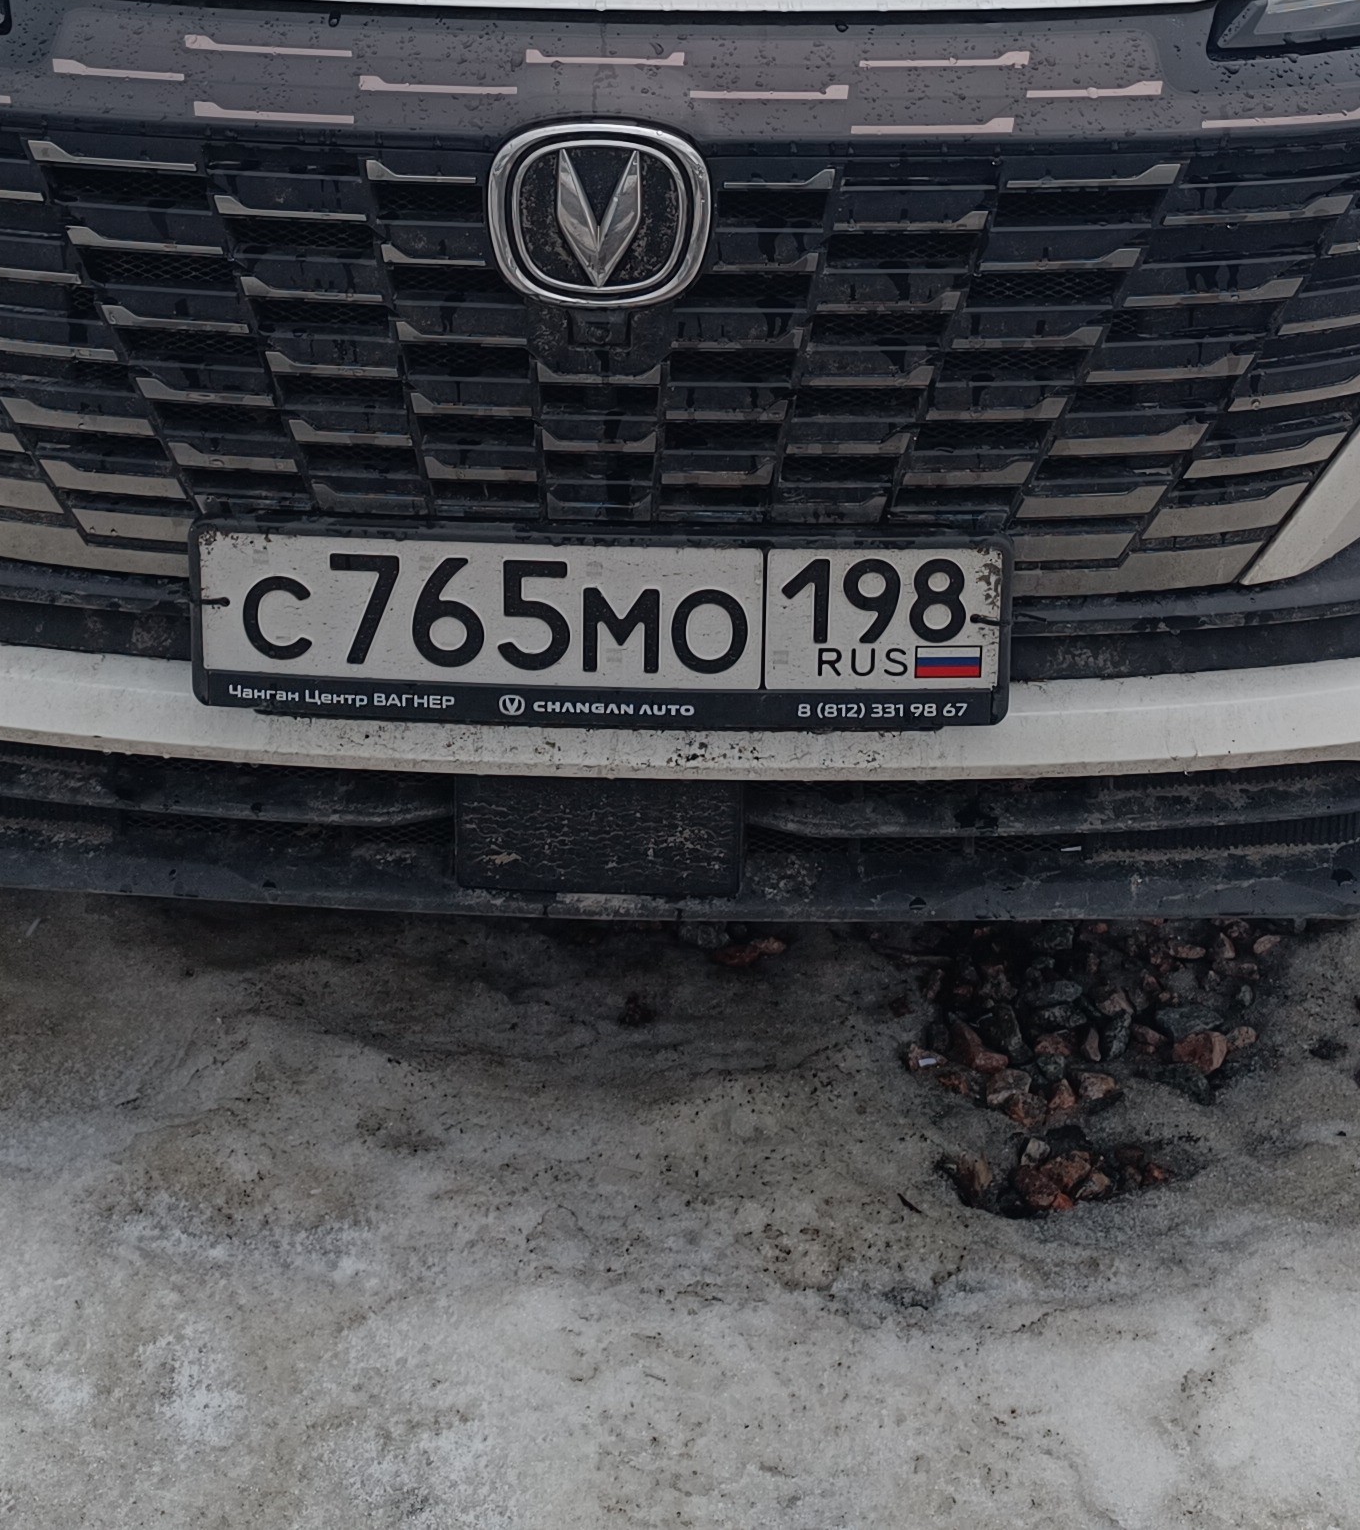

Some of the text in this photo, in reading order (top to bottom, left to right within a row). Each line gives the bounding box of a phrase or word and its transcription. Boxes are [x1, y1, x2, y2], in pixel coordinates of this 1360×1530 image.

[780, 558, 967, 645] 198
[817, 646, 909, 678] RUS
[228, 683, 456, 710] Чанган Центр ВАГНЕР
[532, 700, 695, 717] CHANGAN AUTO
[797, 702, 968, 719] 8 (812) 331 98 67
